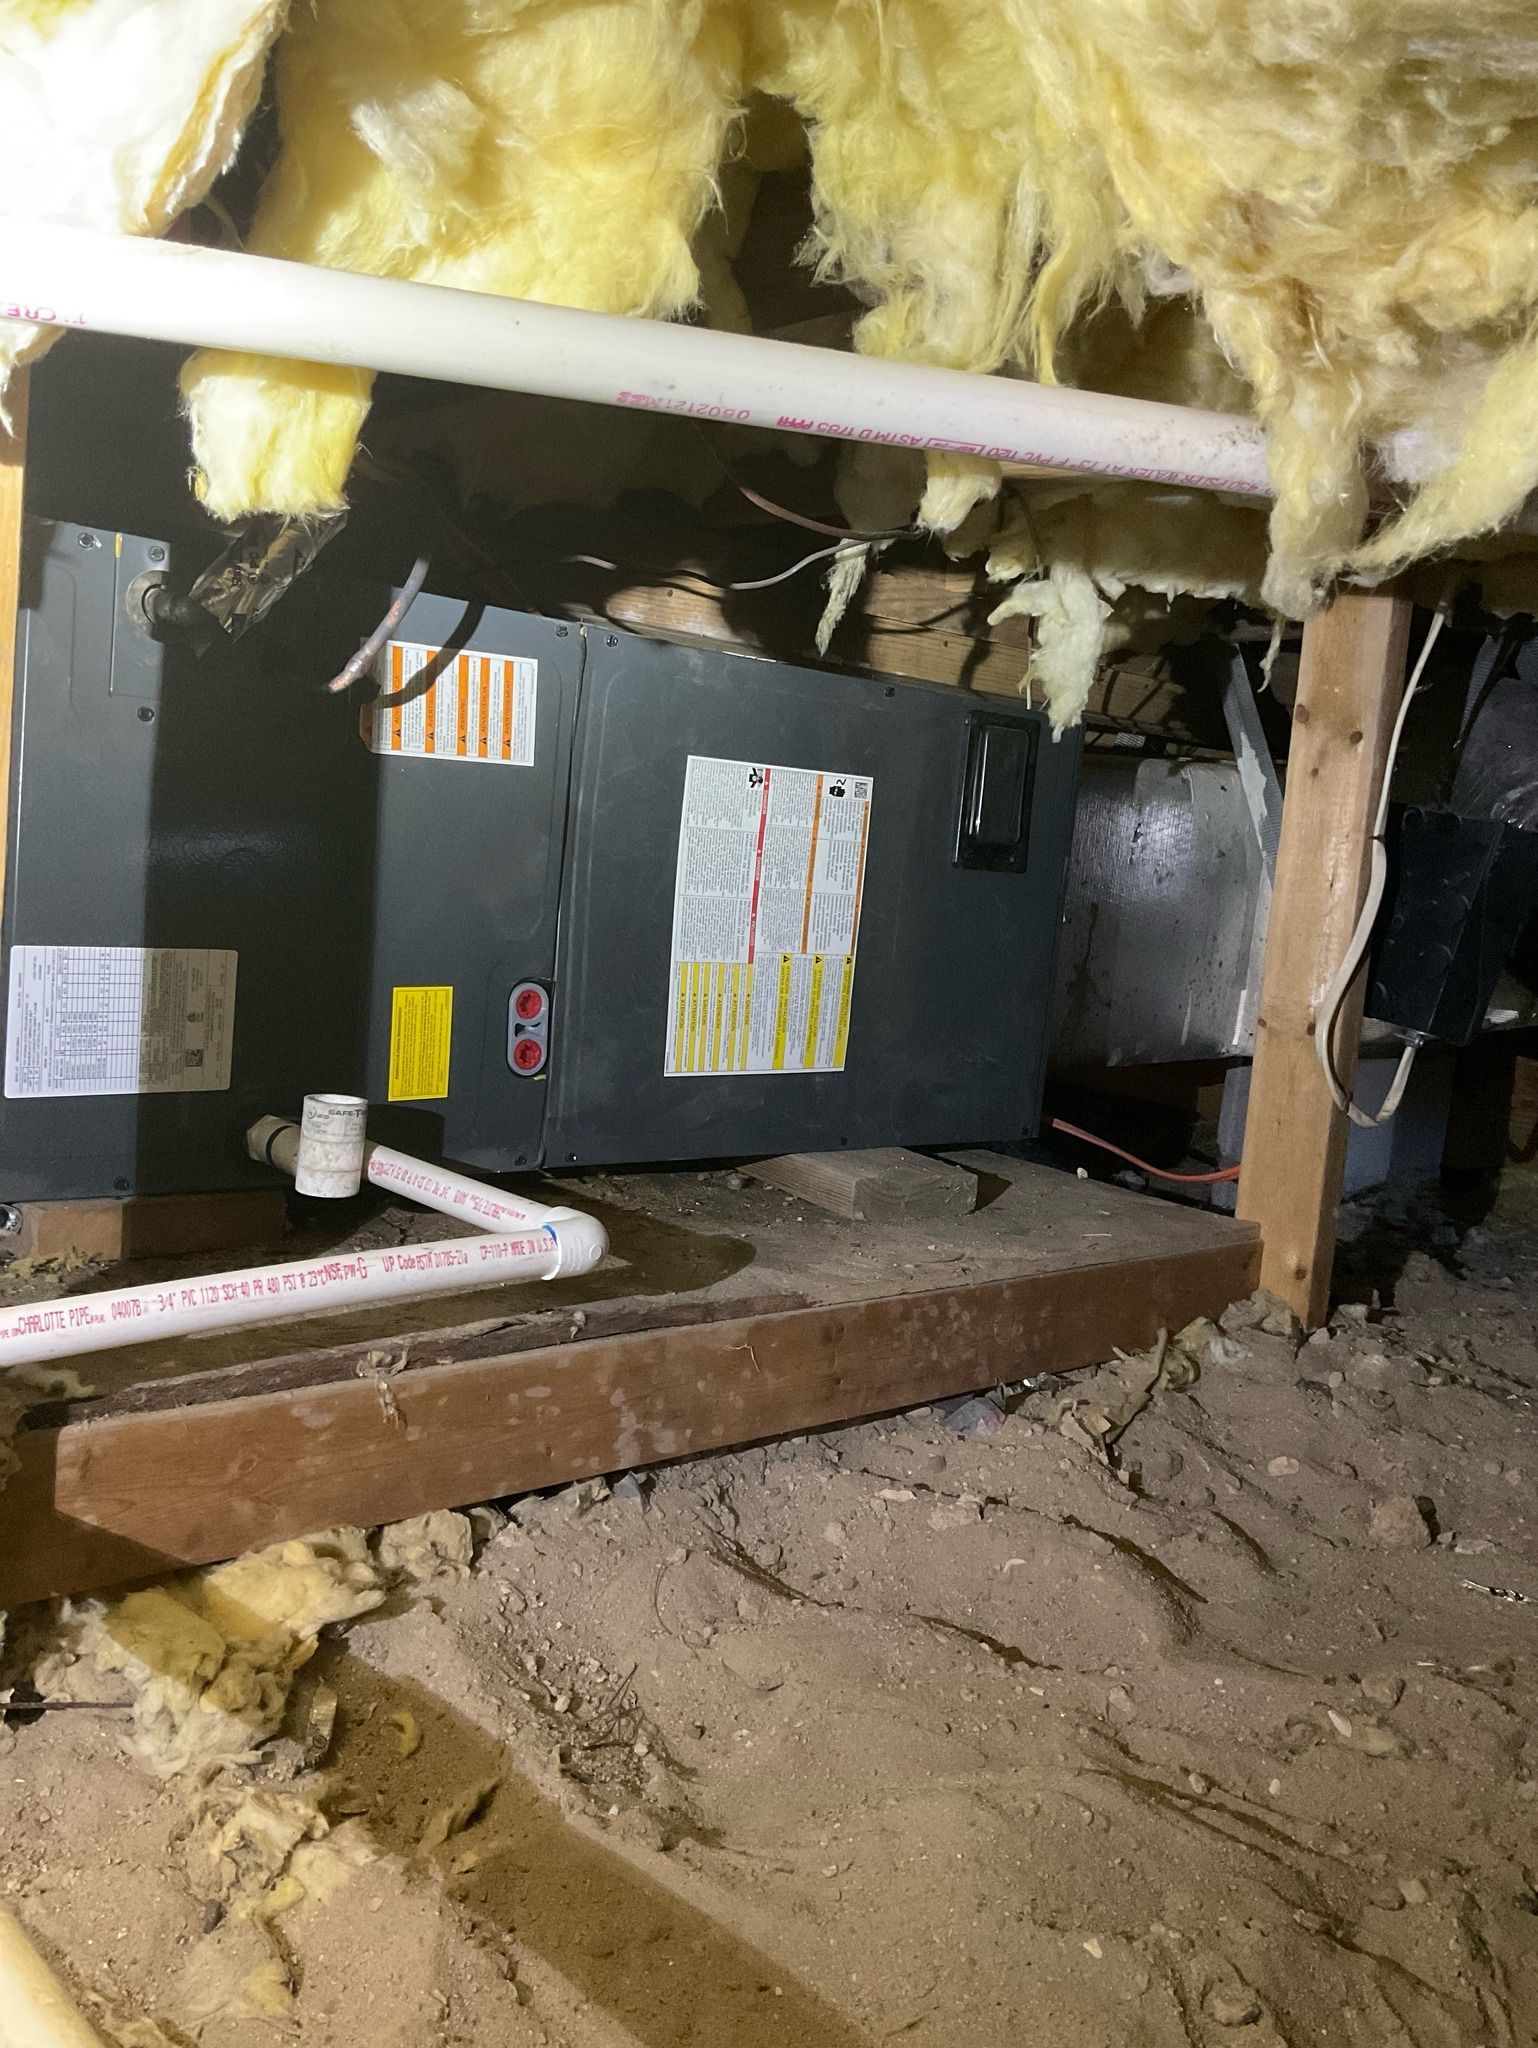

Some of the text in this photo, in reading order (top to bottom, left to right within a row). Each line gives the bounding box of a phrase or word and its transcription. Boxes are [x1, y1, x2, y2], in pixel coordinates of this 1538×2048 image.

[816, 421, 855, 437] 1785
[875, 431, 924, 448] ASTM
[1021, 450, 1053, 465] PVC
[18, 1311, 66, 1336] CHARLOTTE
[69, 1307, 91, 1327] PIPE
[181, 1288, 198, 1307] PVC
[201, 1286, 220, 1305] 1120
[222, 1283, 238, 1301] SCH
[253, 1279, 264, 1297] PR
[282, 1274, 297, 1291] PSI
[382, 1256, 396, 1273] UP
[397, 1255, 416, 1270] Code
